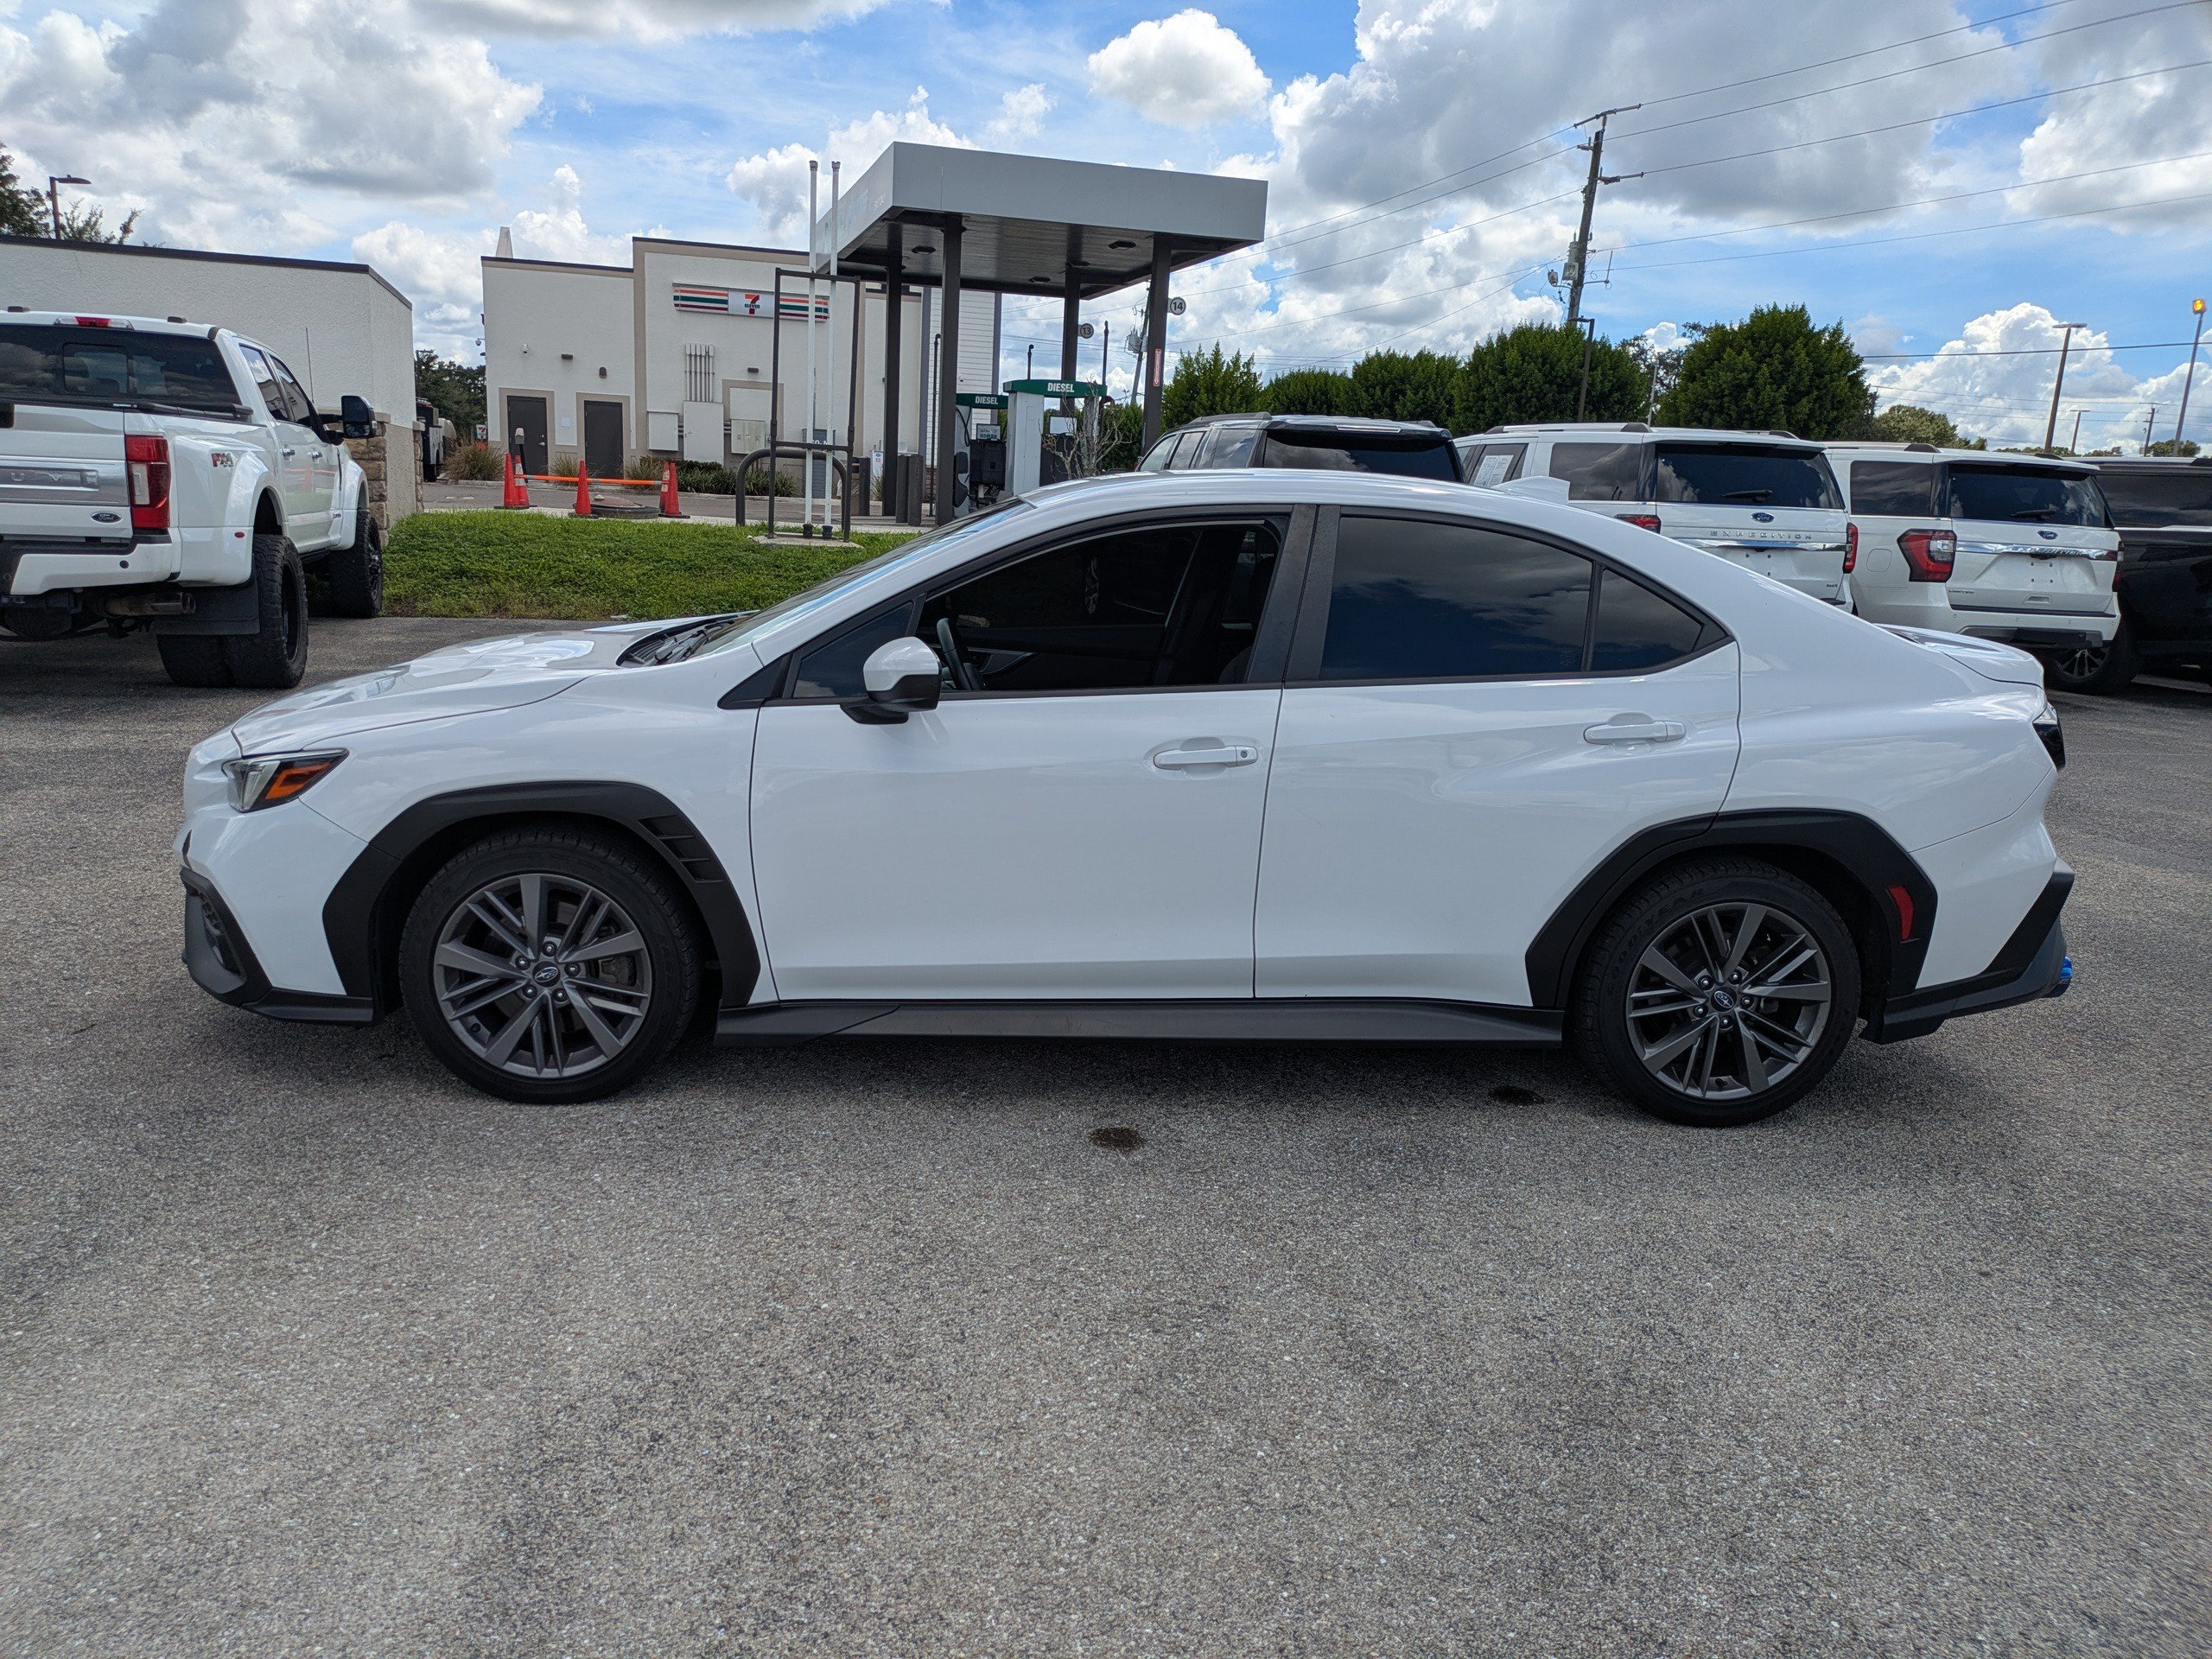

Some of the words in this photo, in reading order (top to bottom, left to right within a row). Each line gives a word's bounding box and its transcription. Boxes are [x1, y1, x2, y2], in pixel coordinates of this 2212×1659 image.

[745, 294, 760, 315] 7
[1173, 302, 1184, 311] 14
[1082, 327, 1091, 335] 13
[1047, 382, 1075, 393] DIESEL
[975, 396, 999, 405] DIESEL
[1710, 531, 1812, 540] EXPEDITION
